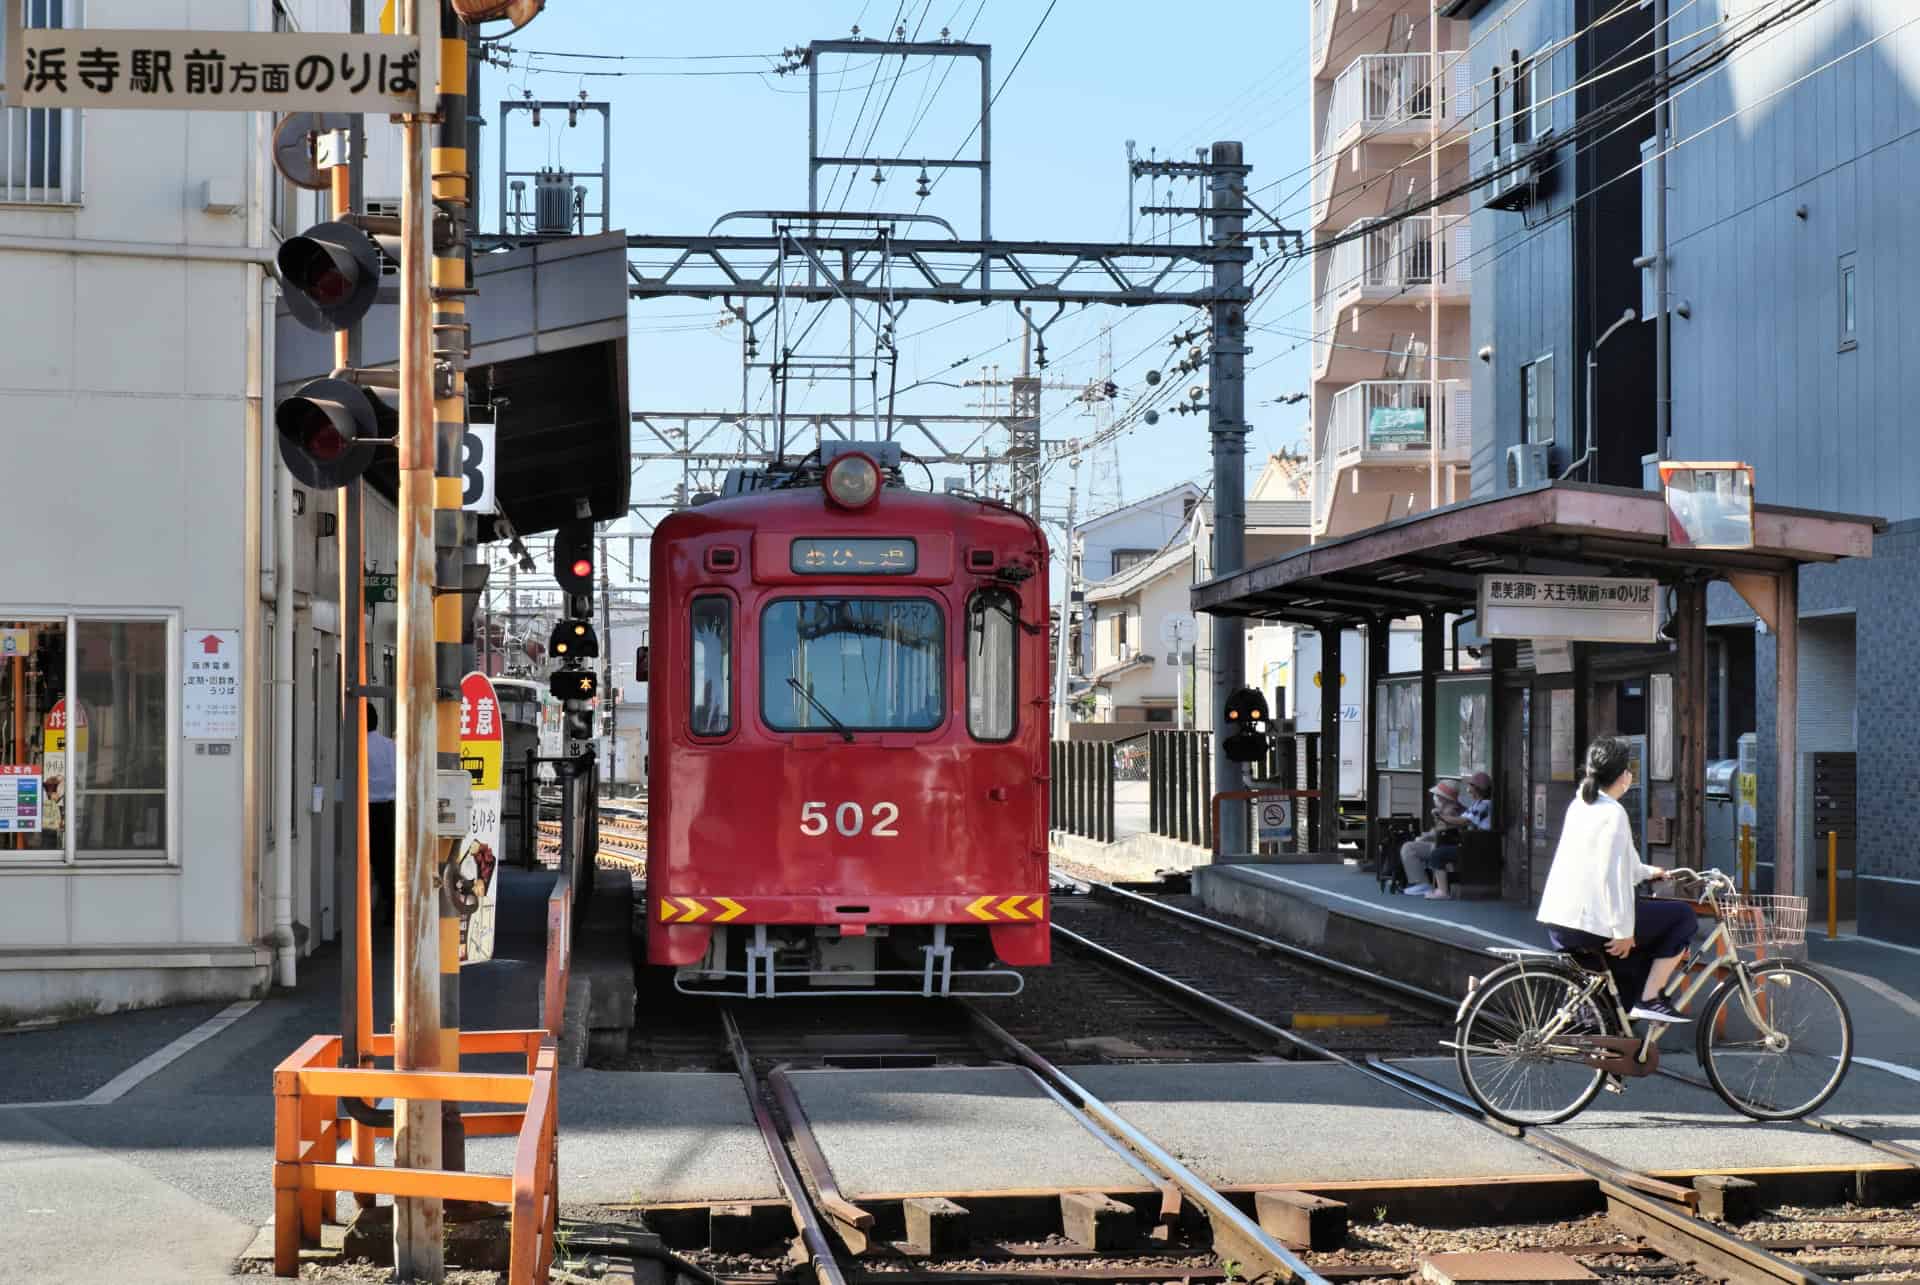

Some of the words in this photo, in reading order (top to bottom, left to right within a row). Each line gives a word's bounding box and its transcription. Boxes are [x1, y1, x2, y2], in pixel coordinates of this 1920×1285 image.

[22, 46, 420, 95] 浜寺駅前方面のりば
[800, 801, 900, 837] 502
